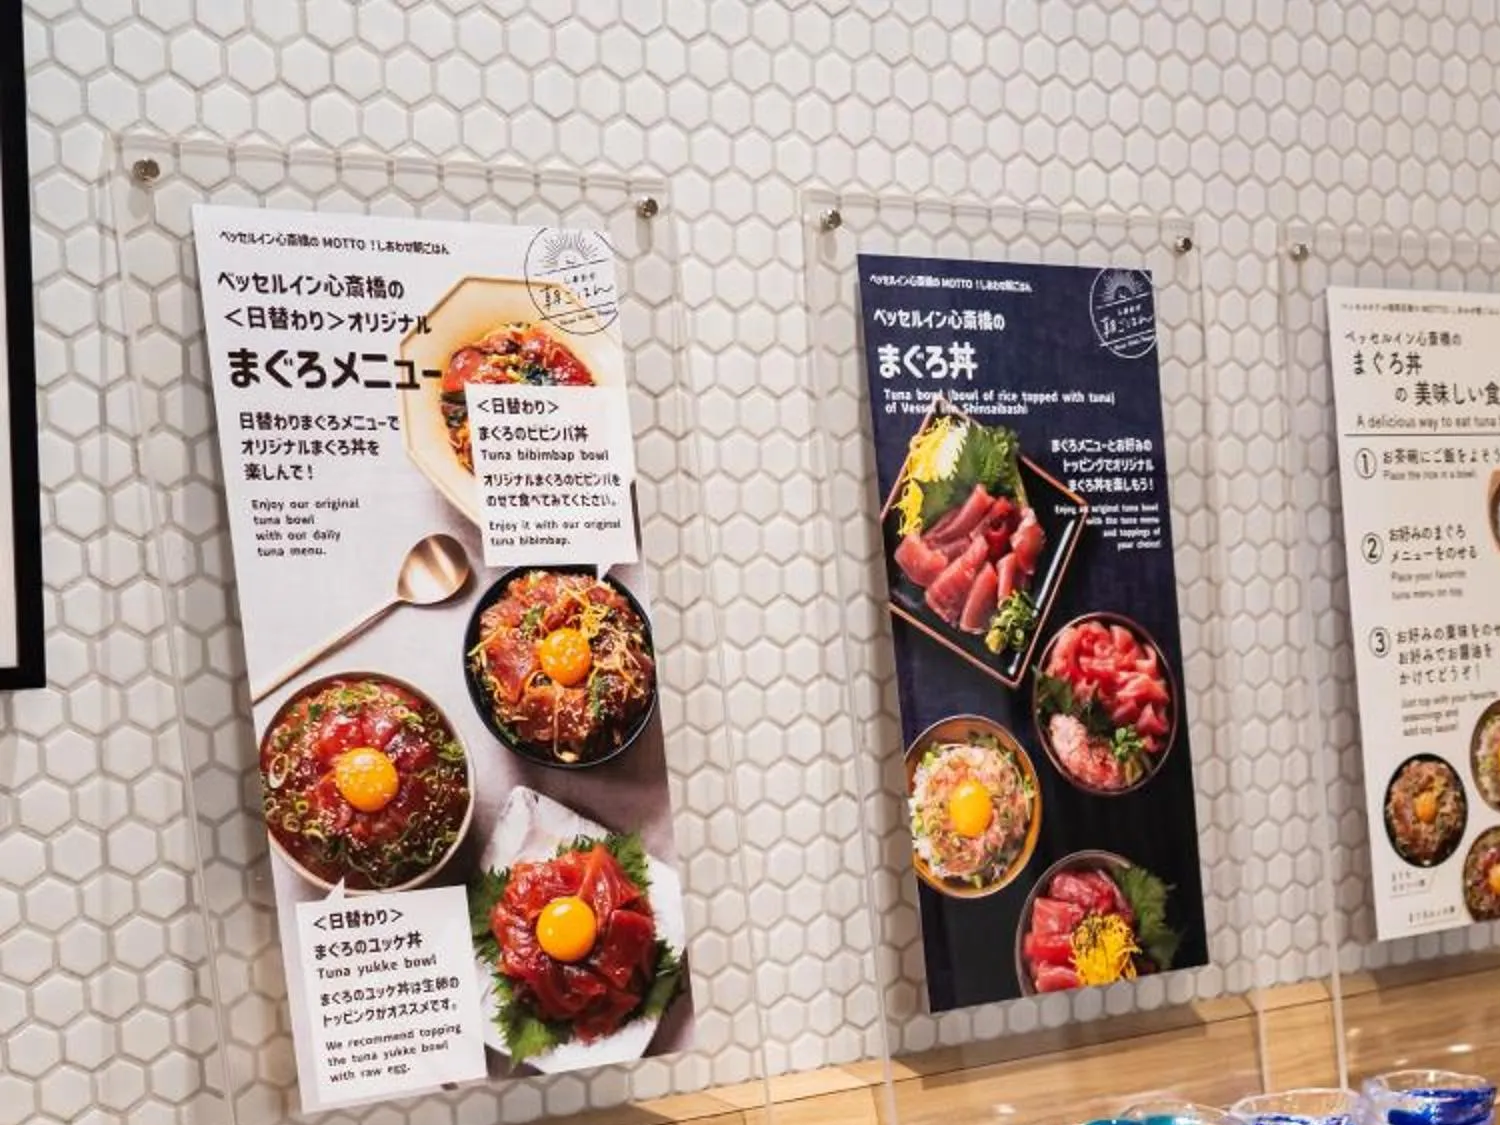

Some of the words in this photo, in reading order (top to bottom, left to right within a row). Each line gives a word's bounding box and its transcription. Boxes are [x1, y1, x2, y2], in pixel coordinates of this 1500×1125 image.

[323, 237, 365, 250] MOTTO
[218, 271, 404, 300] ベッセルイン心斎橋の
[873, 309, 1006, 331] ベッセルイン心斎橋の
[877, 341, 978, 380] まぐろ丼
[1352, 350, 1423, 376] まぐろ丼
[227, 348, 442, 390] まぐろメニュー
[883, 388, 912, 400] Tuna
[983, 389, 995, 401] of
[999, 389, 1018, 402] rice
[1061, 390, 1085, 403] with
[885, 401, 897, 413] of
[239, 411, 400, 431] 日替わりまぐろメニューで
[1357, 416, 1365, 427] A
[1441, 416, 1452, 427] to
[478, 425, 589, 443] まぐろのビビンバ丼
[241, 438, 380, 456] オリジナルまぐろ丼を
[480, 450, 511, 461] Tuna
[517, 449, 575, 462] bibimbap
[581, 449, 609, 461] bowl
[251, 499, 284, 512] Enjoy
[290, 501, 309, 509] our
[315, 498, 359, 511] original
[253, 516, 280, 525] tuna
[285, 515, 315, 525] bowl
[489, 520, 517, 532] Enjoy
[535, 520, 558, 530] with
[562, 521, 580, 529] our
[256, 529, 282, 541] with
[287, 532, 307, 541] our
[313, 529, 341, 542] daily
[490, 537, 515, 546] tuna
[257, 547, 284, 557] tuna
[314, 931, 423, 961] まぐろのユッケ丼
[316, 964, 350, 979] Tuna
[357, 959, 398, 976] yukke
[404, 954, 437, 969] bowl
[325, 1040, 342, 1051] We
[348, 1030, 415, 1048] recommend
[419, 1023, 461, 1037] topping
[327, 1055, 346, 1066] the
[352, 1051, 378, 1063] tuna
[383, 1047, 416, 1061] yukke
[421, 1040, 449, 1052] bowl
[330, 1070, 355, 1082] with
[360, 1068, 382, 1079] raw
